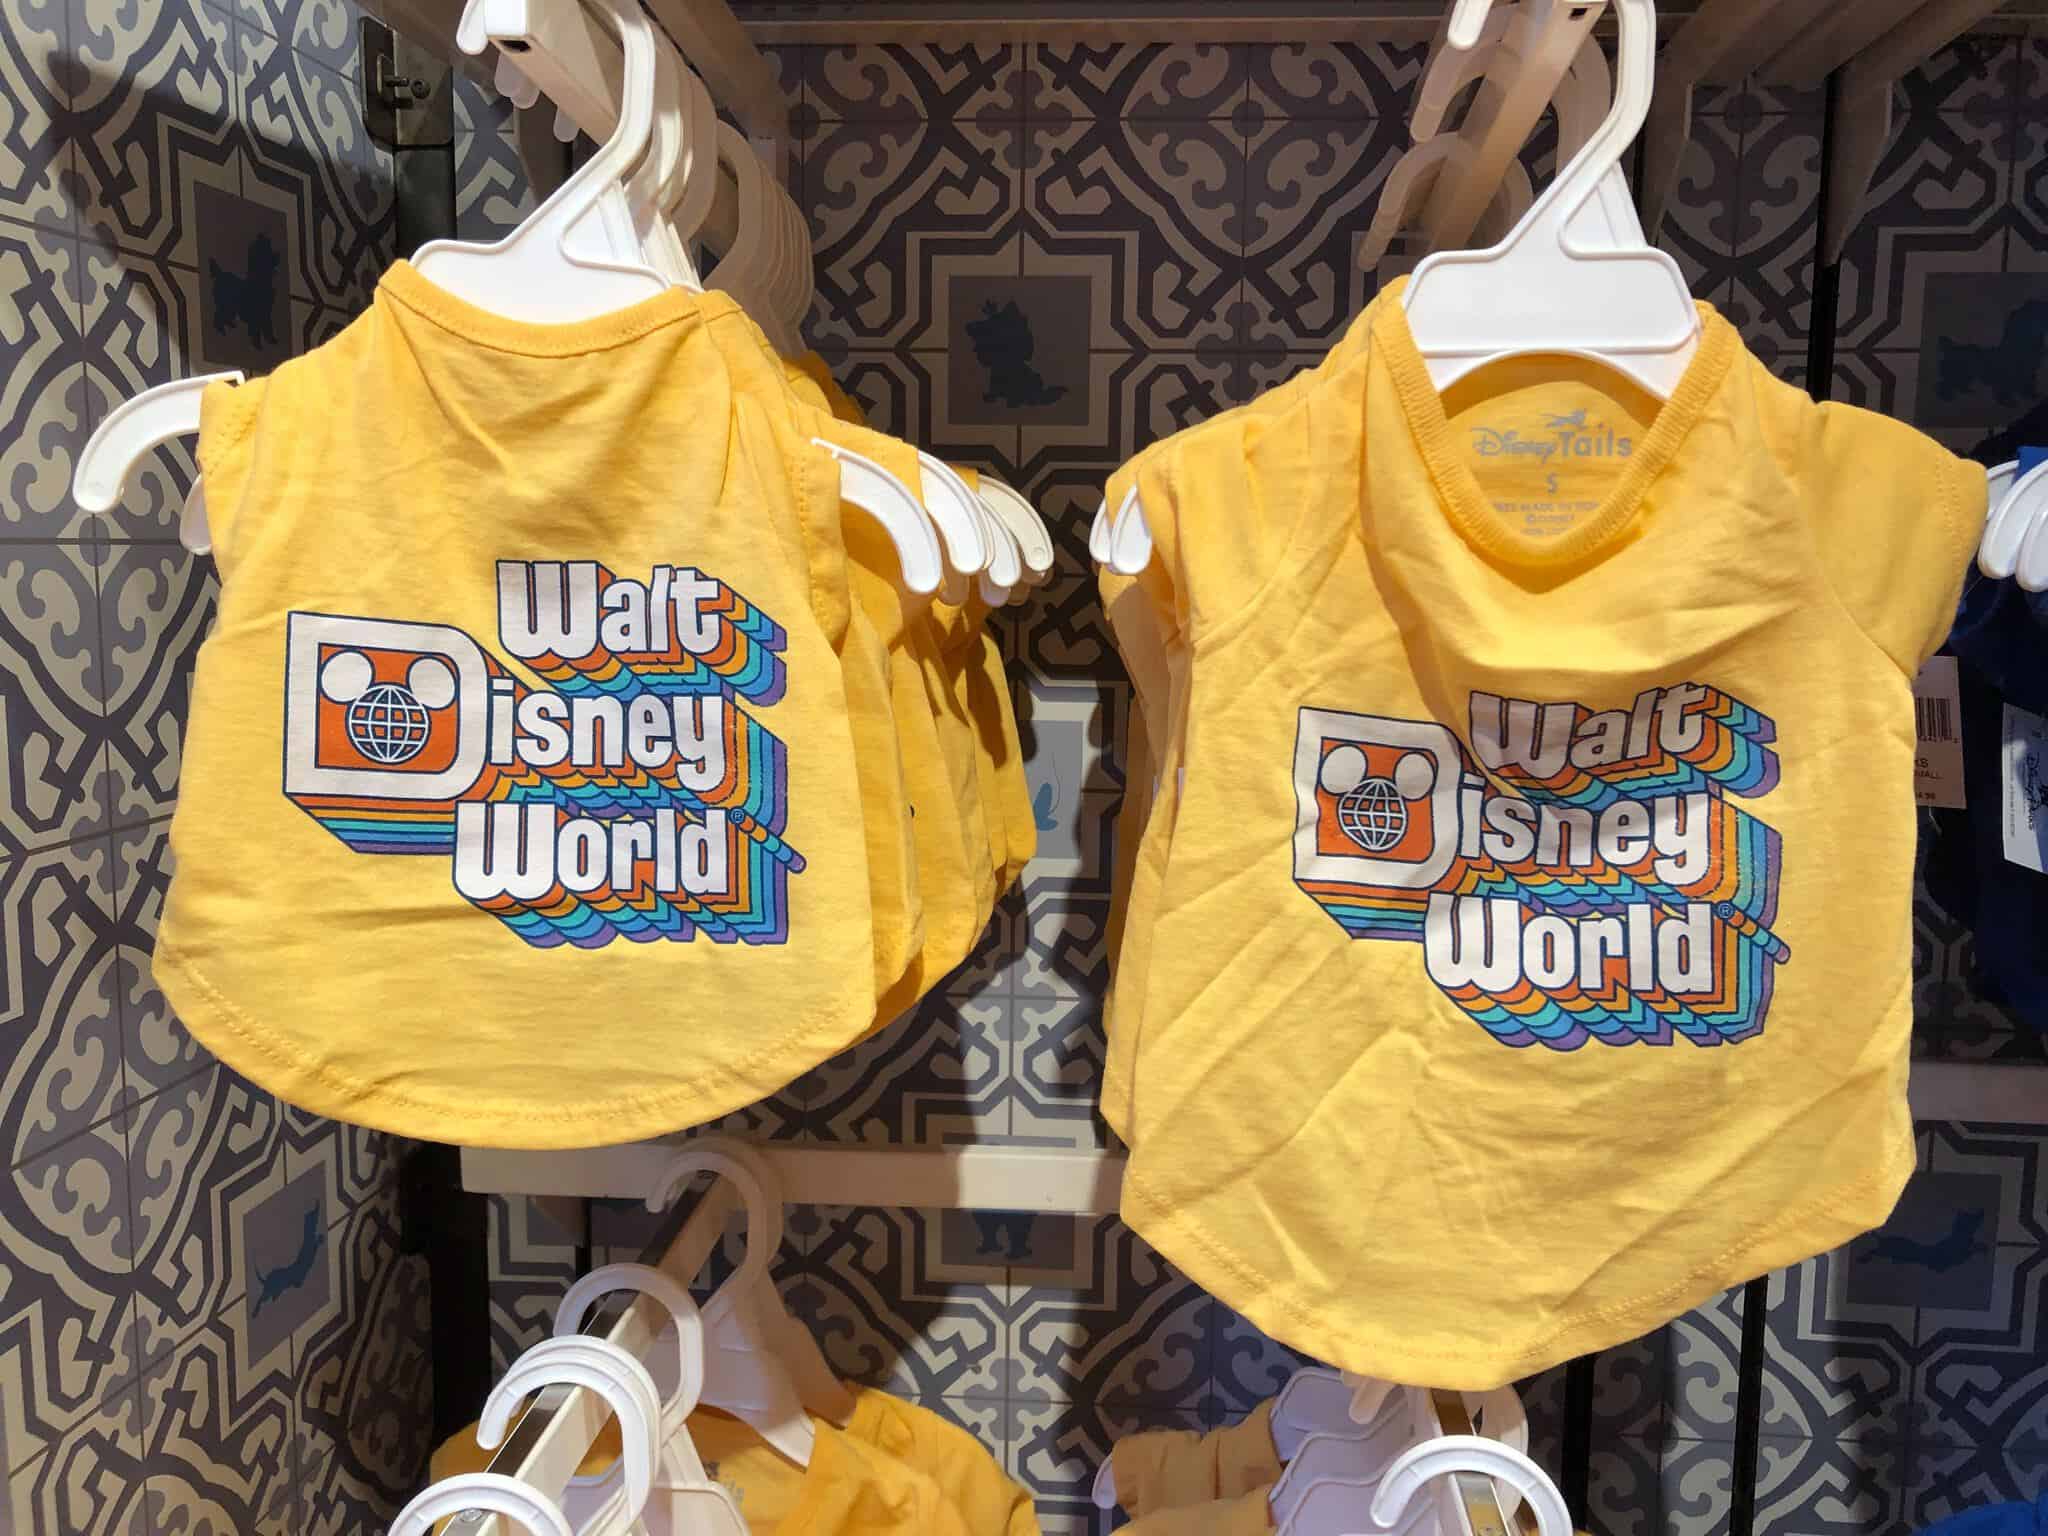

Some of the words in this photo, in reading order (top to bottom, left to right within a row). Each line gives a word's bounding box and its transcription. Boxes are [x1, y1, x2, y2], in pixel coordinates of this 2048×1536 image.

[1471, 426, 1556, 465] Disney
[1558, 423, 1633, 457] Tails
[1546, 472, 1559, 495] S
[496, 559, 724, 660] Walt
[282, 610, 728, 801] Disney
[1469, 681, 1708, 780] Walt
[1292, 706, 1713, 891] Disney
[451, 800, 730, 902] World
[1424, 891, 1715, 994] World
